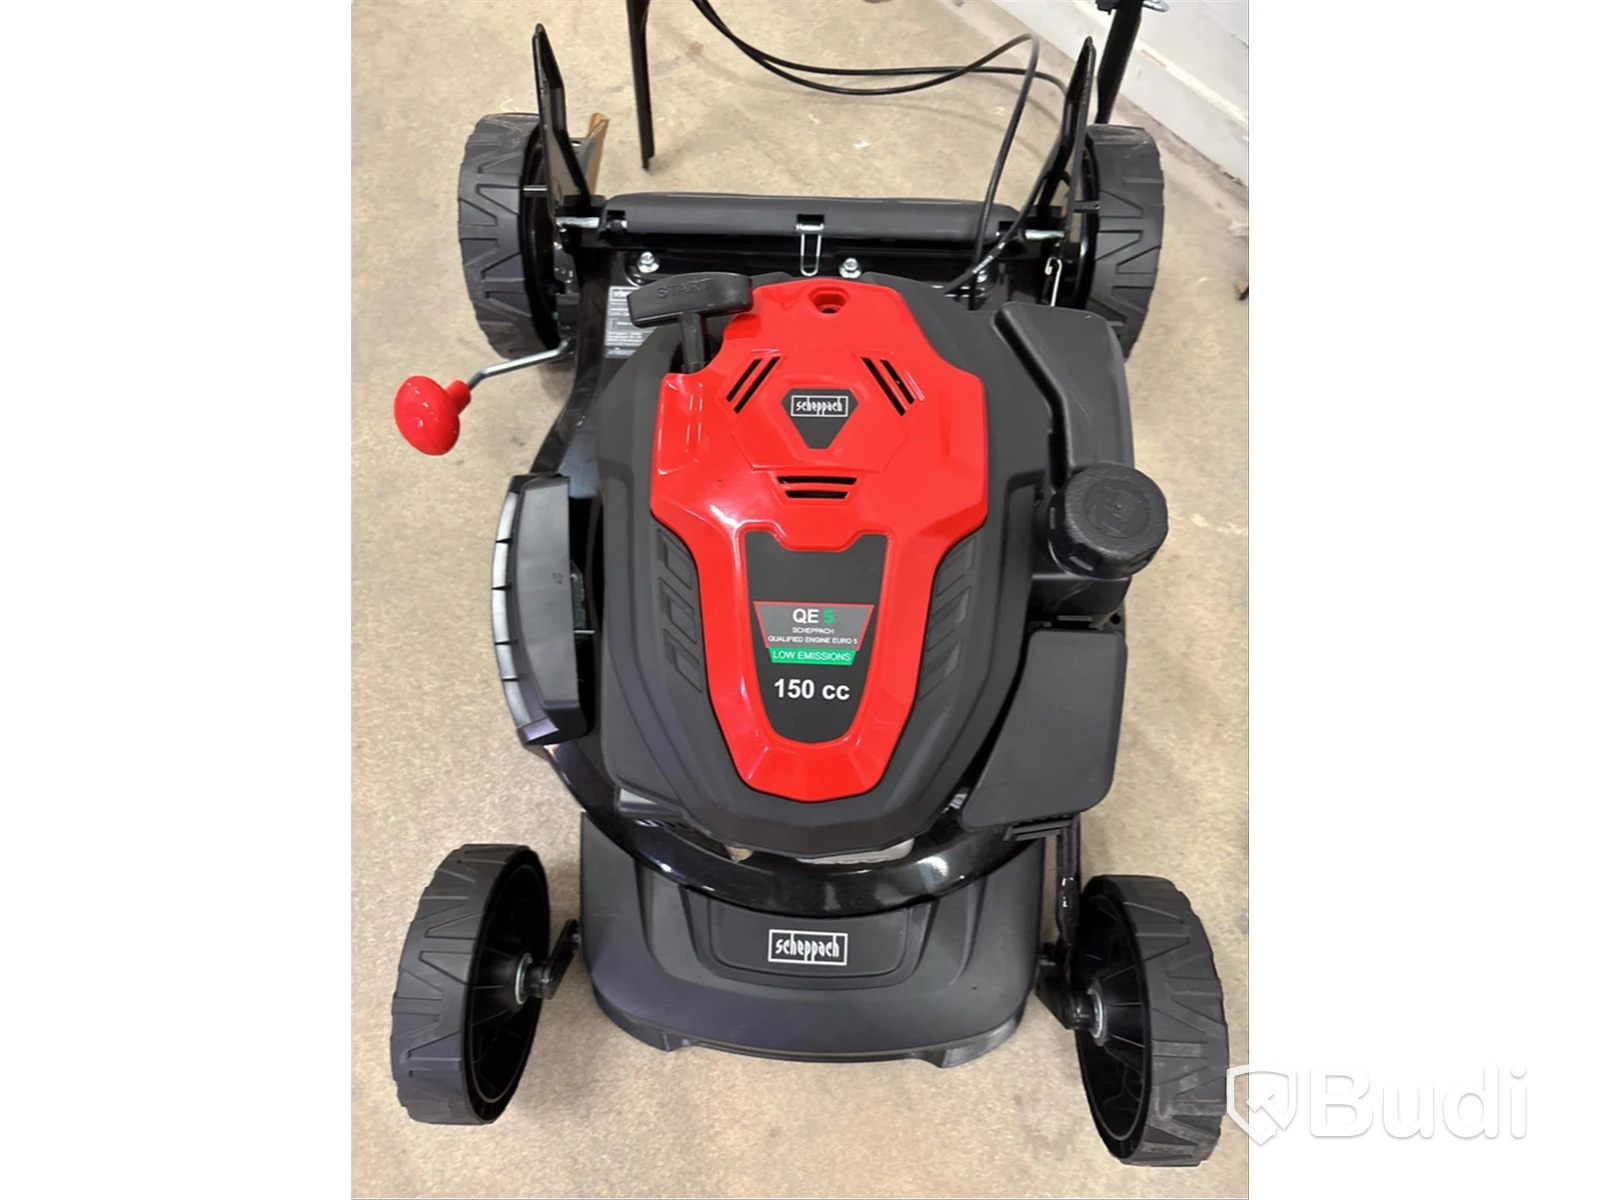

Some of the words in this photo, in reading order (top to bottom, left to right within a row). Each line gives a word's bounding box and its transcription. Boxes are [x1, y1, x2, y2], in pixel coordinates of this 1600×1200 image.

[656, 278, 712, 299] START
[795, 397, 843, 416] scheppach
[792, 608, 820, 624] QE
[823, 608, 835, 624] 5
[792, 627, 834, 635] SCHEPPACH
[768, 635, 804, 643] QUALIFIED
[805, 636, 831, 644] ENGINE
[832, 637, 851, 645] EURO
[773, 650, 796, 660] LOW
[797, 651, 851, 662] EMISSIONS
[774, 678, 815, 699] 150
[822, 684, 850, 700] cc
[775, 932, 839, 962] scheppach
